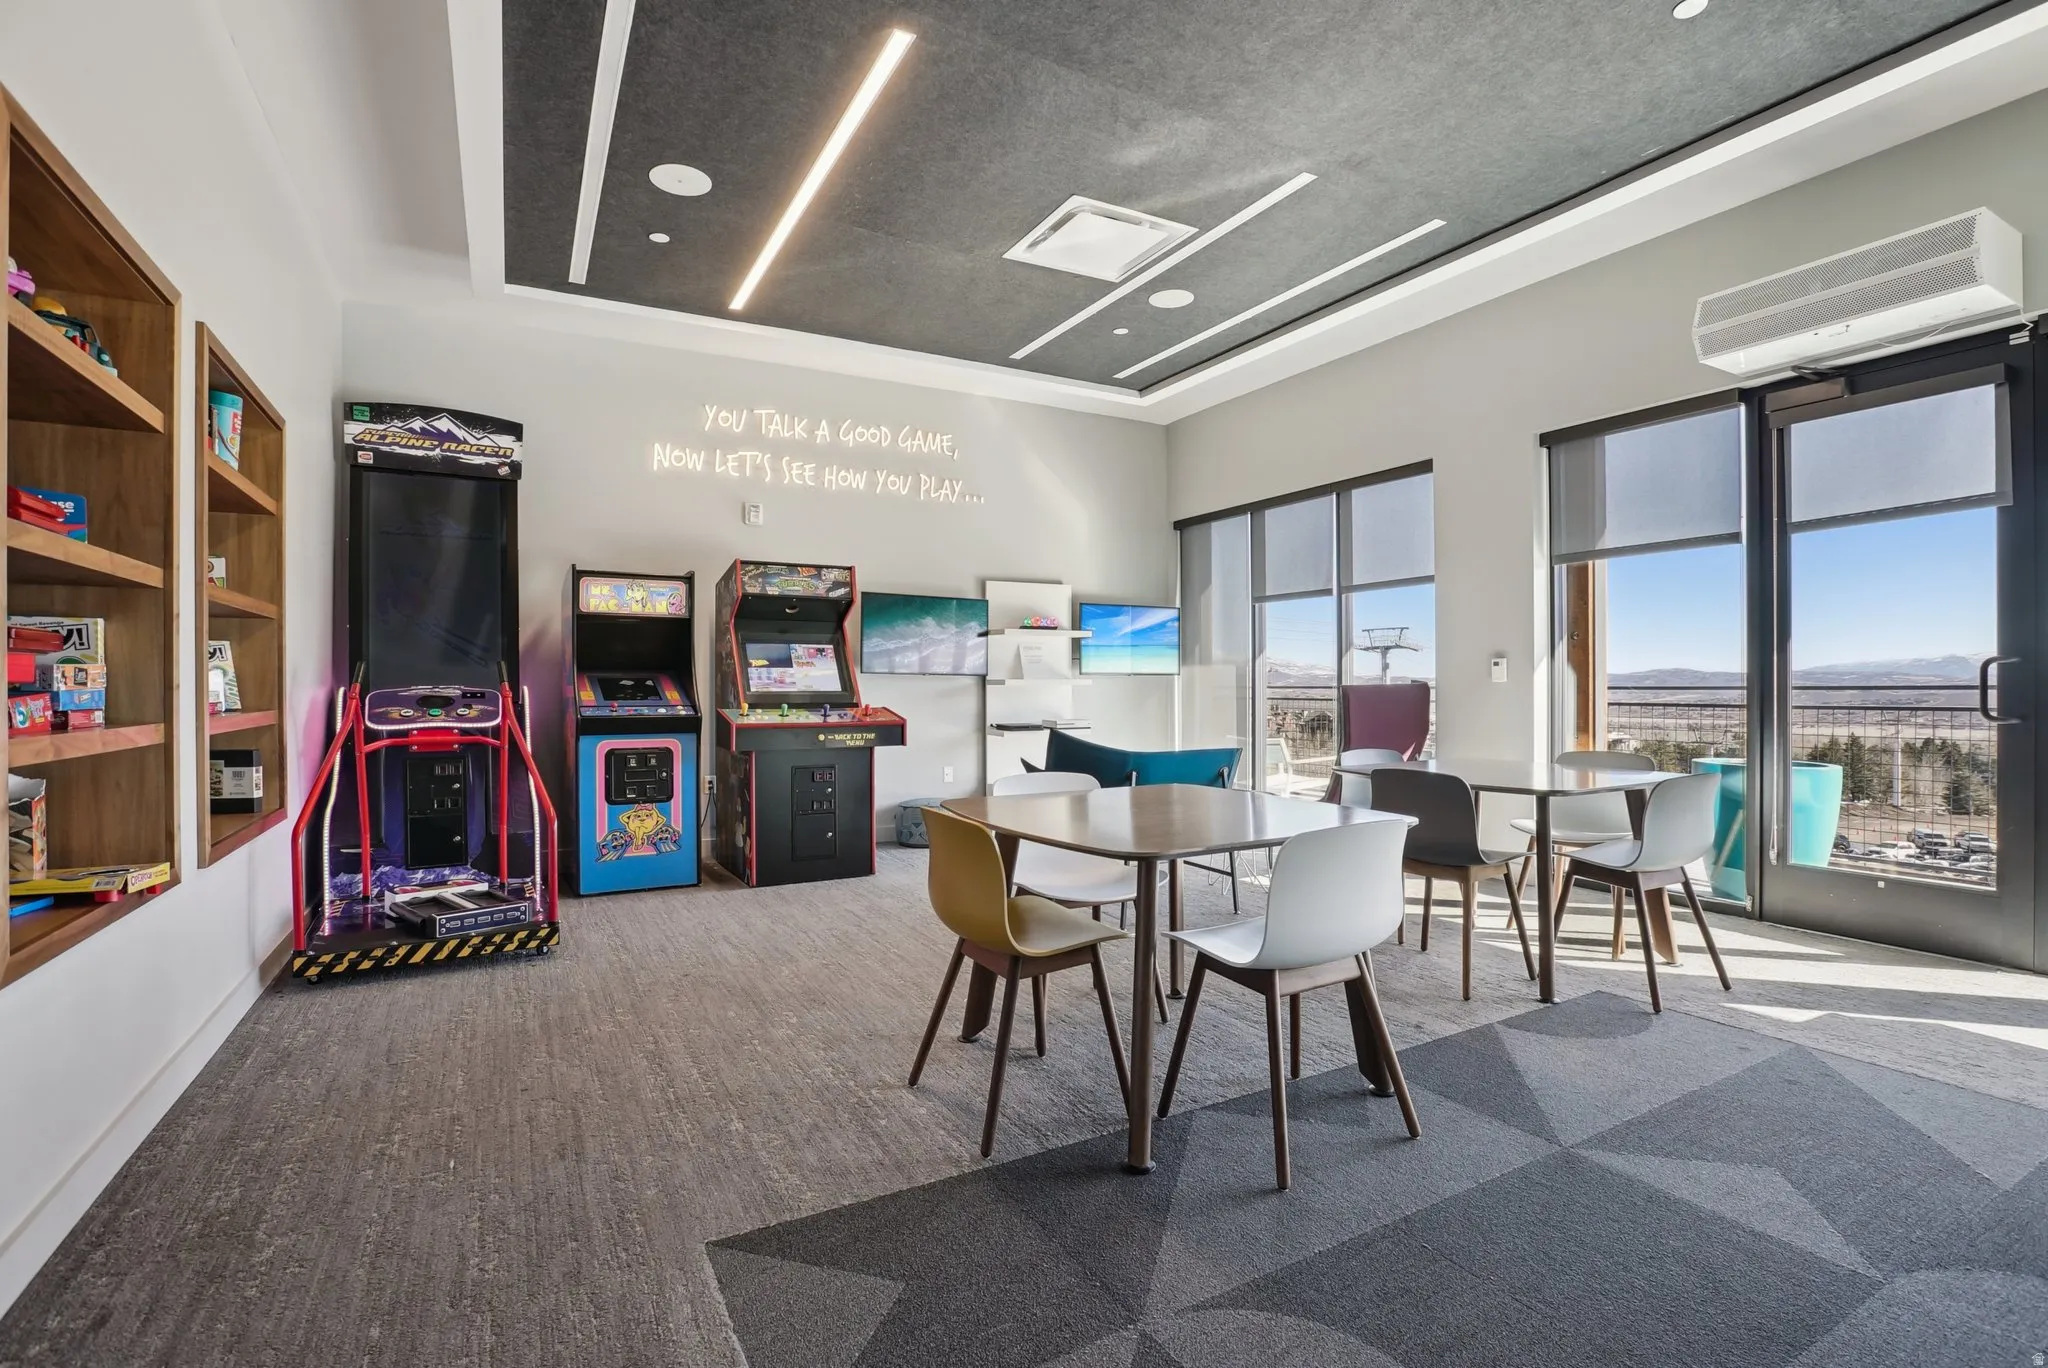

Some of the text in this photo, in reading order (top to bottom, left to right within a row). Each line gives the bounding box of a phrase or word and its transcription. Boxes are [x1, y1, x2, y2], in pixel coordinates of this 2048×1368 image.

[353, 433, 514, 457] ALPINE RACER
[703, 405, 959, 461] YOU TALK A GOOD GAME,
[652, 442, 705, 472] NOW
[714, 449, 771, 482] LET'S
[782, 456, 816, 485] SEE
[824, 464, 867, 491] HOW
[875, 469, 912, 495] YOU
[589, 598, 667, 613] PAC-MAN
[863, 732, 876, 740] THE
